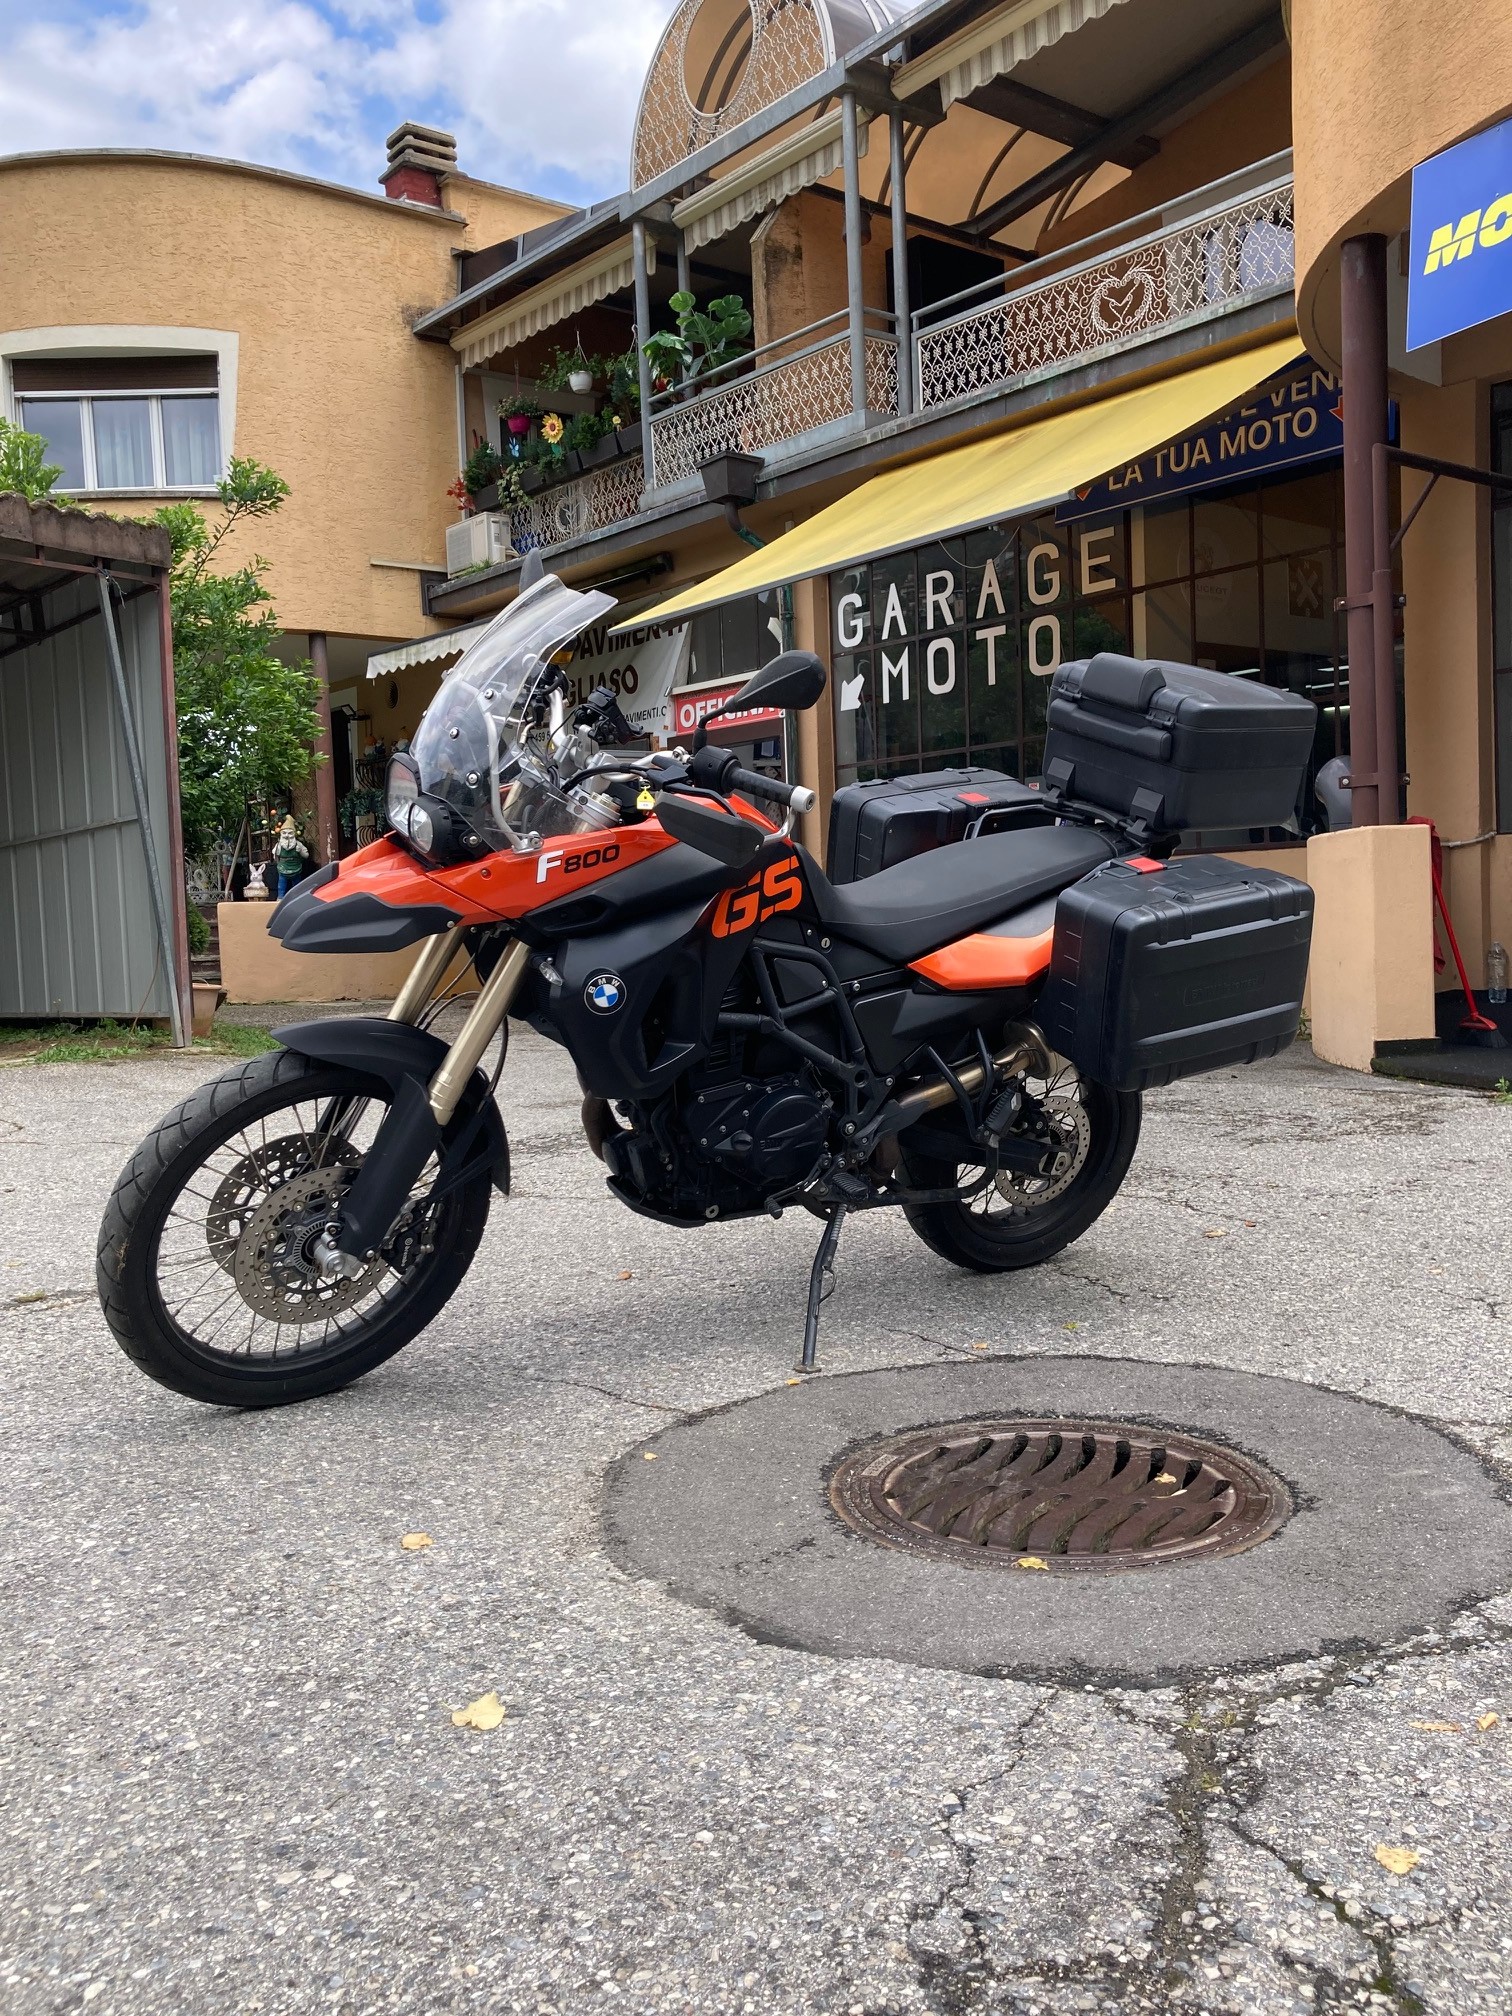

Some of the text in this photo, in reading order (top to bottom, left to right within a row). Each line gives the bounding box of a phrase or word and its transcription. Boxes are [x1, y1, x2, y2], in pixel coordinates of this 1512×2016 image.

[1423, 192, 1512, 275] MO
[1270, 370, 1344, 408] VEN
[1108, 463, 1144, 492] LA
[1154, 438, 1211, 479] TUA
[1219, 405, 1319, 461] MOTO
[837, 526, 1117, 649] GARAGE
[881, 614, 1062, 704] MOTO
[536, 844, 621, 884] F800
[711, 855, 803, 939] GS
[587, 976, 621, 995] BMW
